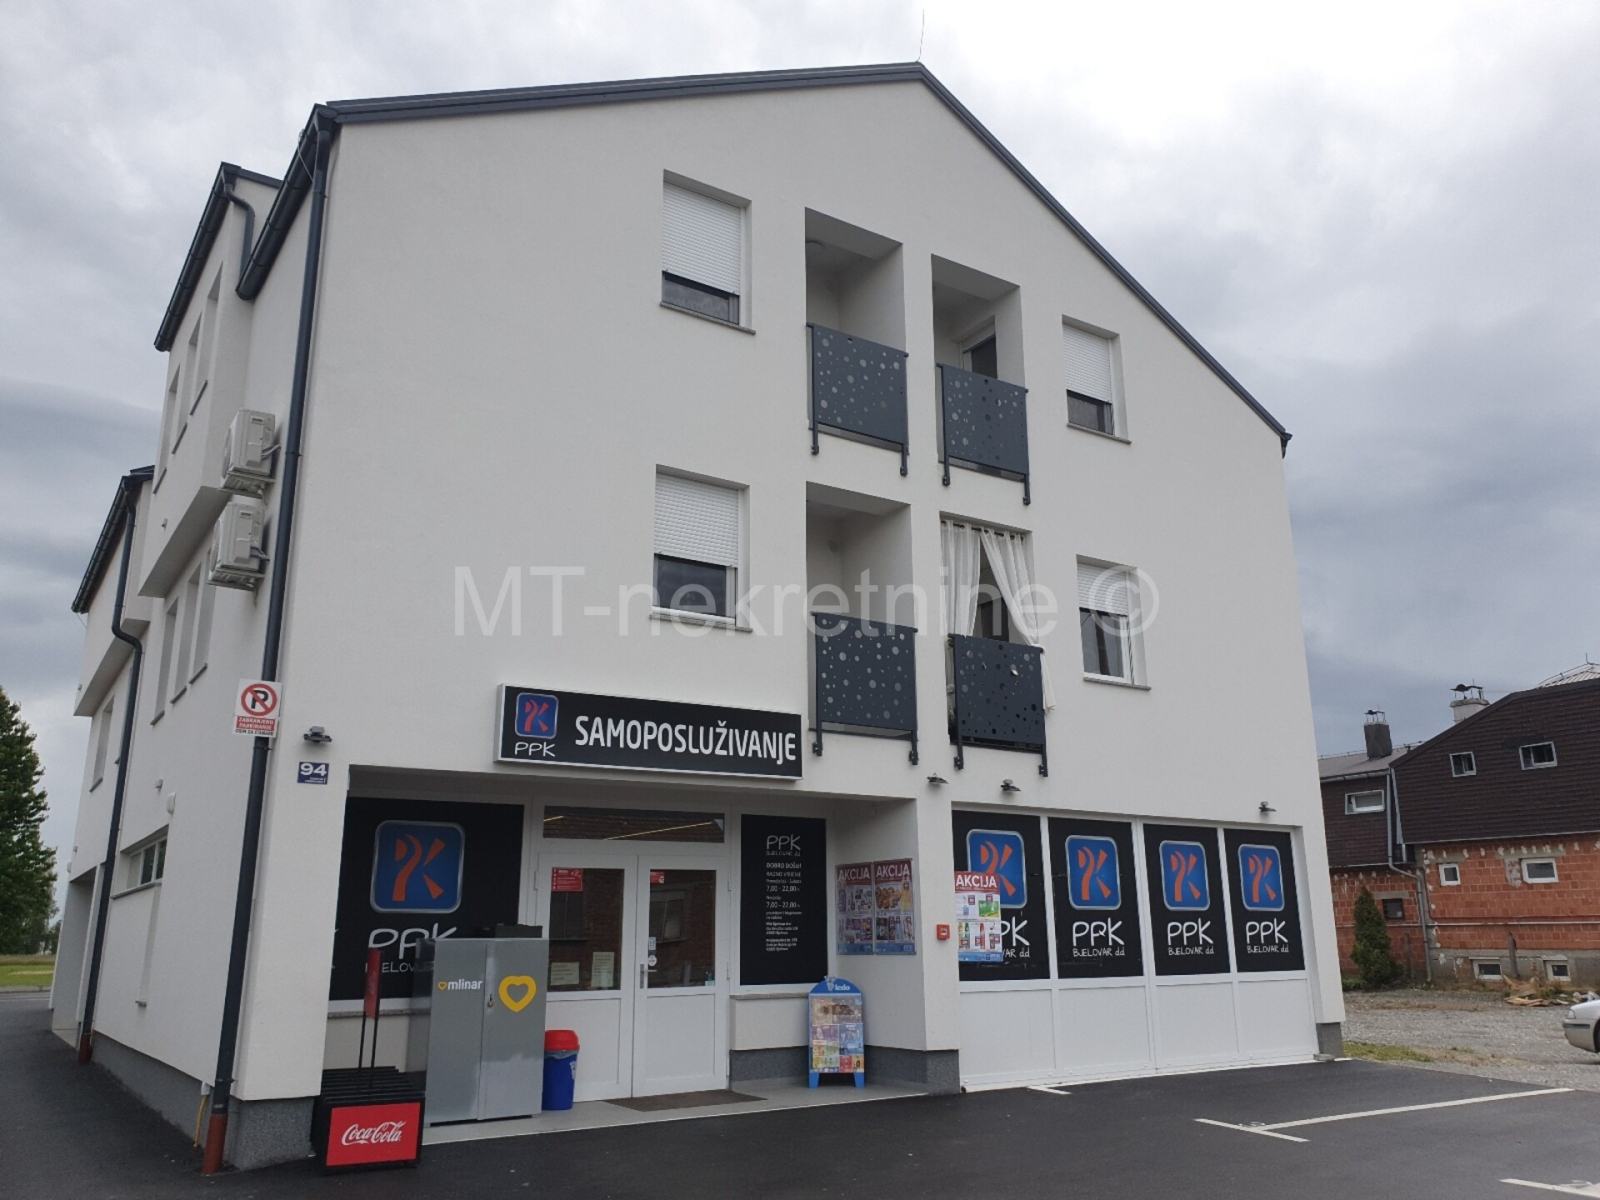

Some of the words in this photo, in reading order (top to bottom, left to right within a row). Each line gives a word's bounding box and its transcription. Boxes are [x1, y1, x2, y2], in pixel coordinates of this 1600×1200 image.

[575, 715, 796, 765] SAMOPOSLUŽIVANJE
[514, 741, 556, 758] PPK
[300, 763, 327, 776] 94
[766, 834, 801, 850] PPK
[838, 866, 871, 881] AKCIJA
[876, 863, 911, 878] AKCIJA
[955, 874, 998, 888] AKCIJA
[1000, 916, 1030, 946] PK
[1072, 917, 1125, 947] PPK
[1167, 917, 1214, 946] PPK
[1246, 917, 1288, 945] PPK
[1072, 948, 1112, 958] BJELOVAR
[1168, 946, 1204, 956] BJELOVAR
[1247, 944, 1280, 954] BJELOVAR
[447, 978, 484, 992] mlinar
[341, 1120, 406, 1146] Coca-Cola
